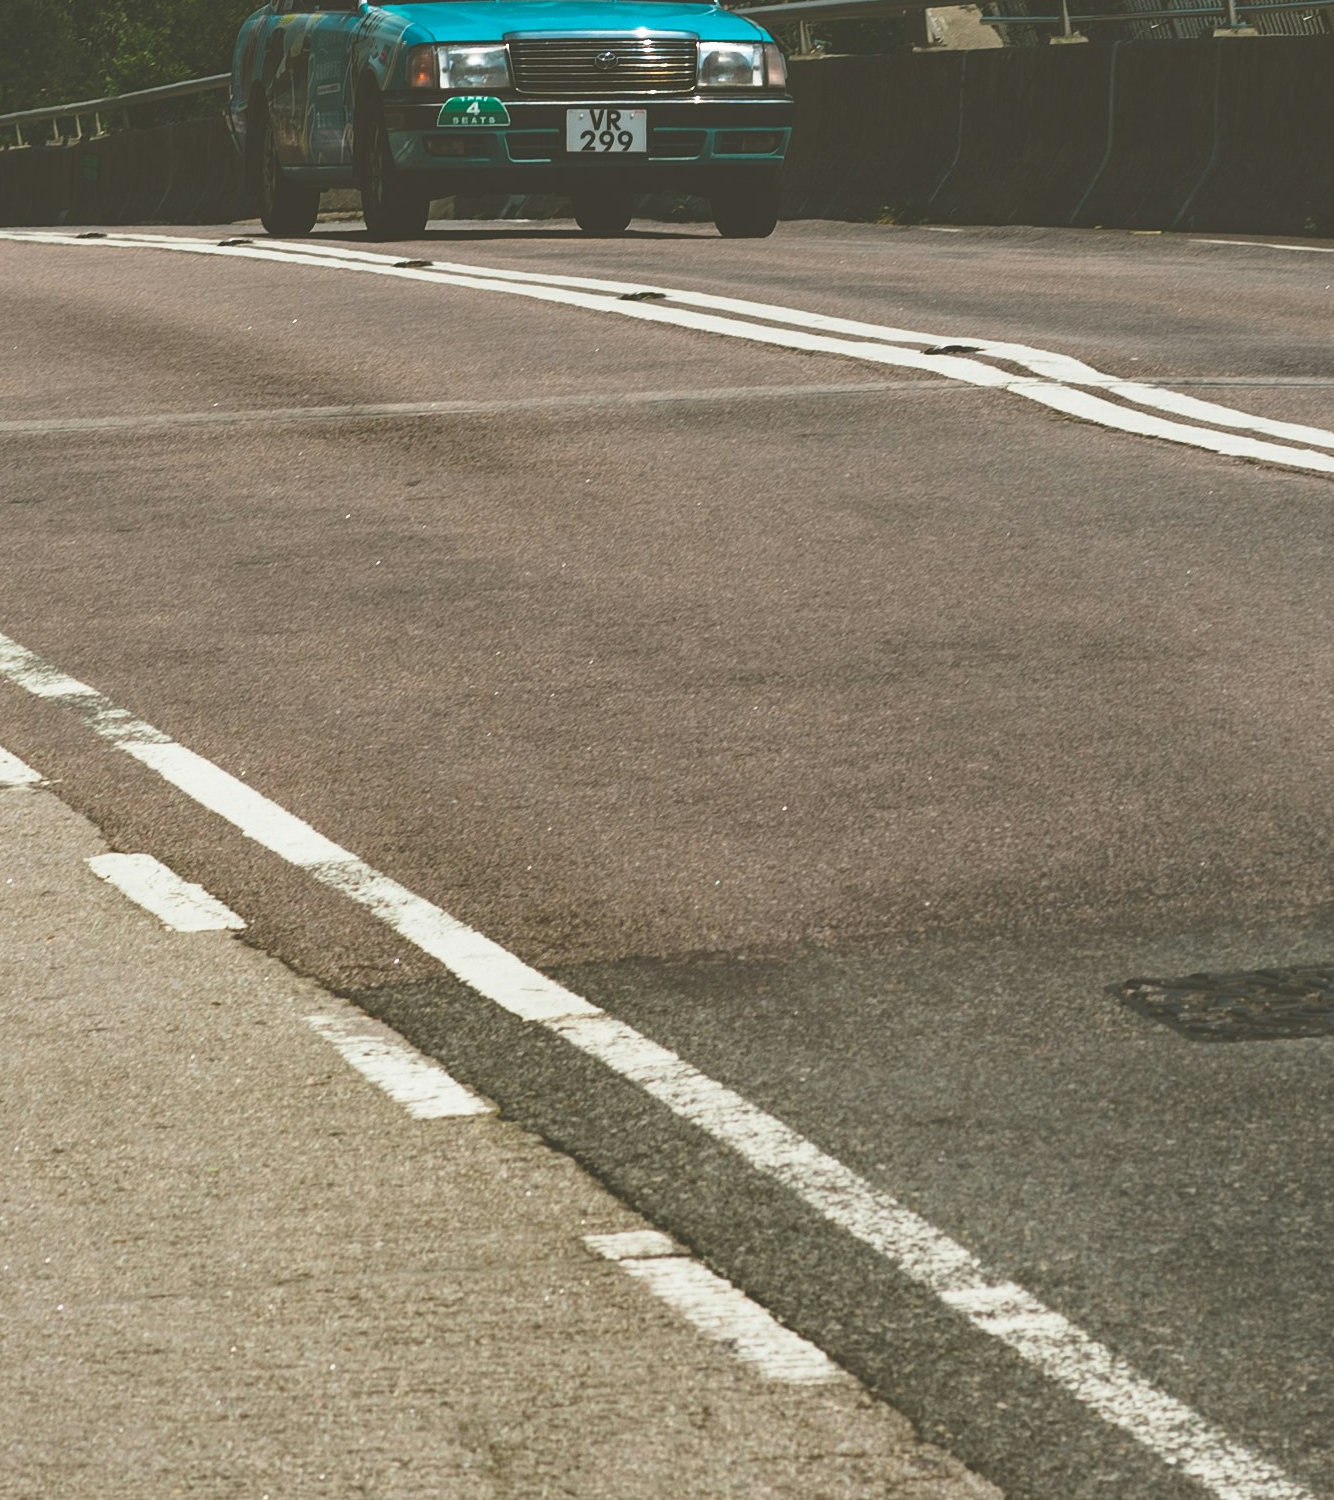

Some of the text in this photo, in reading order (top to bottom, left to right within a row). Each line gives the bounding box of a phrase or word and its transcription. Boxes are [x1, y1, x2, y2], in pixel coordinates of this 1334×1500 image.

[466, 101, 481, 116] 4
[452, 116, 496, 125] SEATS
[589, 109, 622, 131] VR
[580, 130, 634, 152] 299
